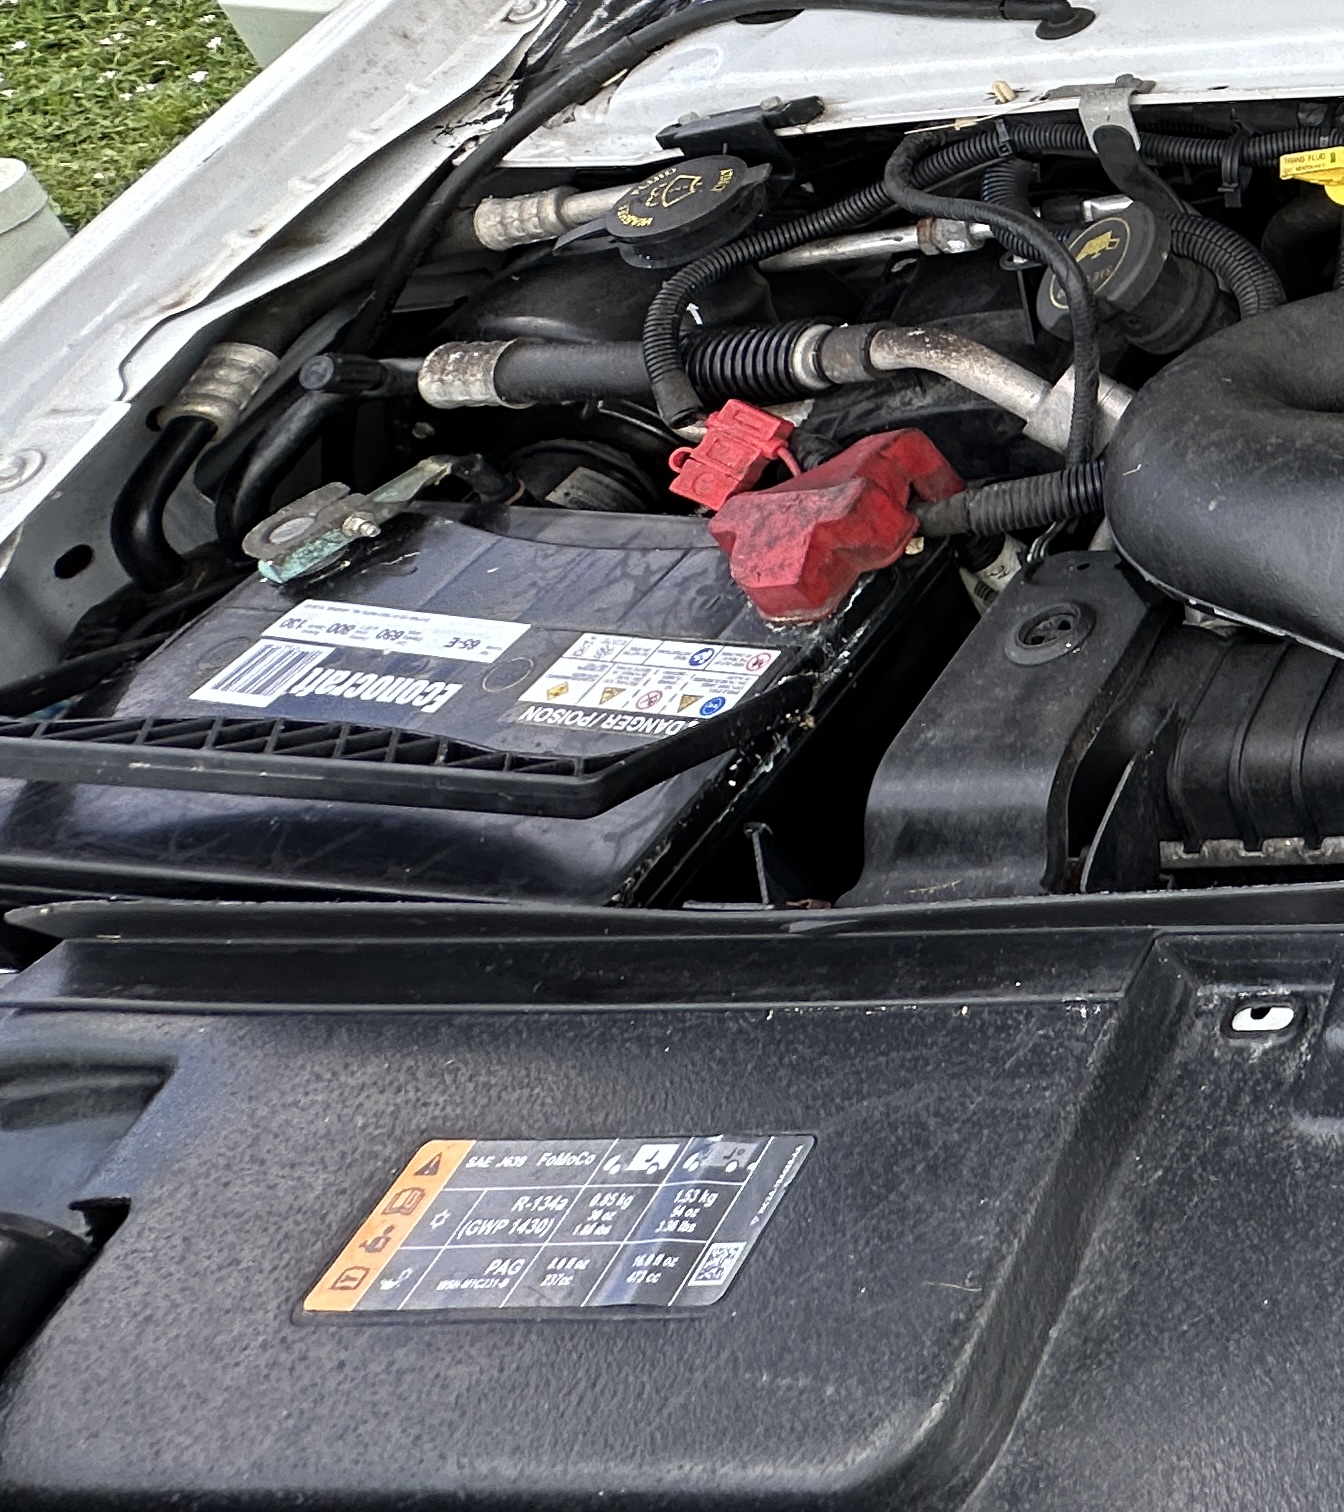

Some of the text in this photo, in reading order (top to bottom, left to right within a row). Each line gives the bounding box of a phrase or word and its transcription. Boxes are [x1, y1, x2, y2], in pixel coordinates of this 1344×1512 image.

[289, 667, 464, 713] Econocraft
[604, 713, 685, 737] DANGER
[466, 1155, 494, 1169] SAE
[536, 1151, 597, 1167] FoMoCo
[511, 1195, 571, 1213] R-134a
[616, 1192, 636, 1211] kg
[673, 1188, 721, 1208] 1.53 kg
[457, 1217, 557, 1240] (GWP 1430)
[484, 1258, 527, 1276] PAG
